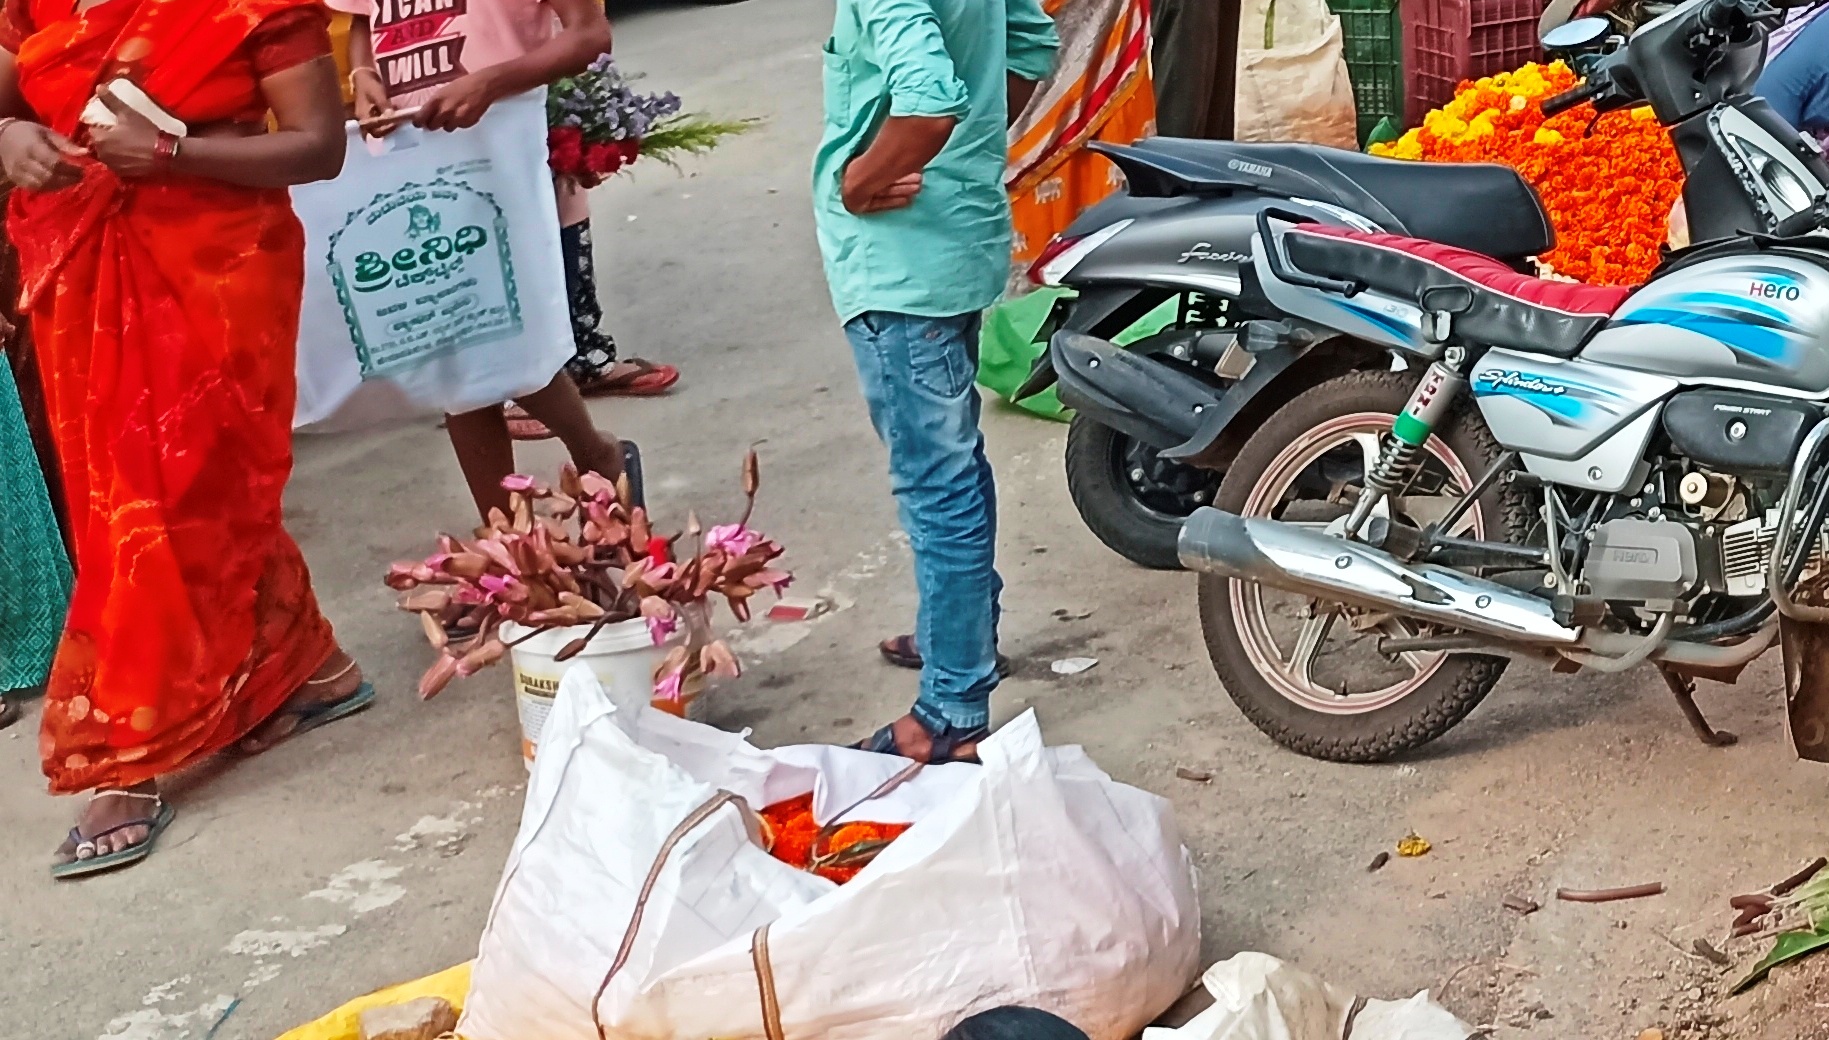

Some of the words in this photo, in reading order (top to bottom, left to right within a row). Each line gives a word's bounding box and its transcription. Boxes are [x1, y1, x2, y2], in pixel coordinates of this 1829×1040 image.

[388, 45, 454, 86] WILL
[1238, 161, 1272, 177] YAMAHA
[353, 225, 488, 293] ಶ್ರೀನಿಧಿ
[1750, 282, 1800, 301] Hero
